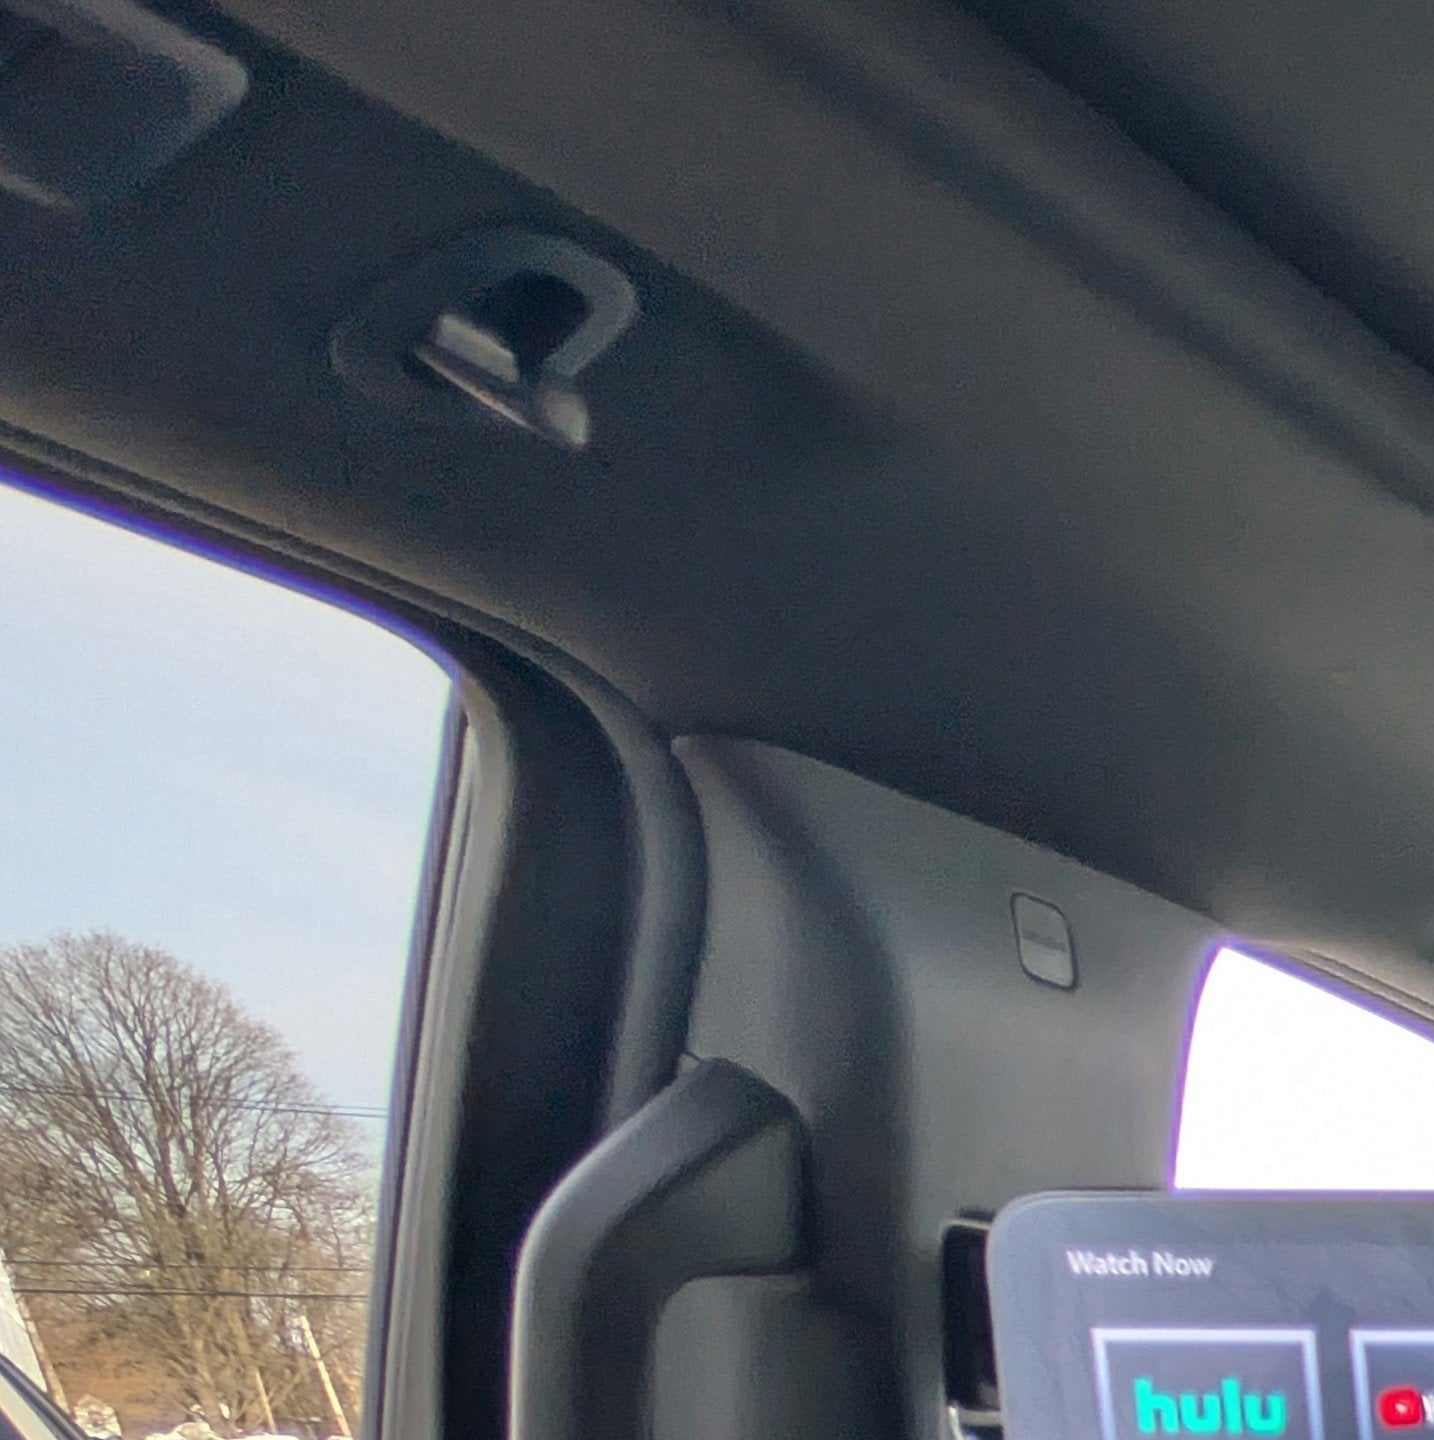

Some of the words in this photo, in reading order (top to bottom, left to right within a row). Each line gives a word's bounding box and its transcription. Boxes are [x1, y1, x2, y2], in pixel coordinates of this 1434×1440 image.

[1066, 1249, 1149, 1276] Watch
[1152, 1252, 1213, 1278] Now
[1133, 1377, 1286, 1436] hulu
